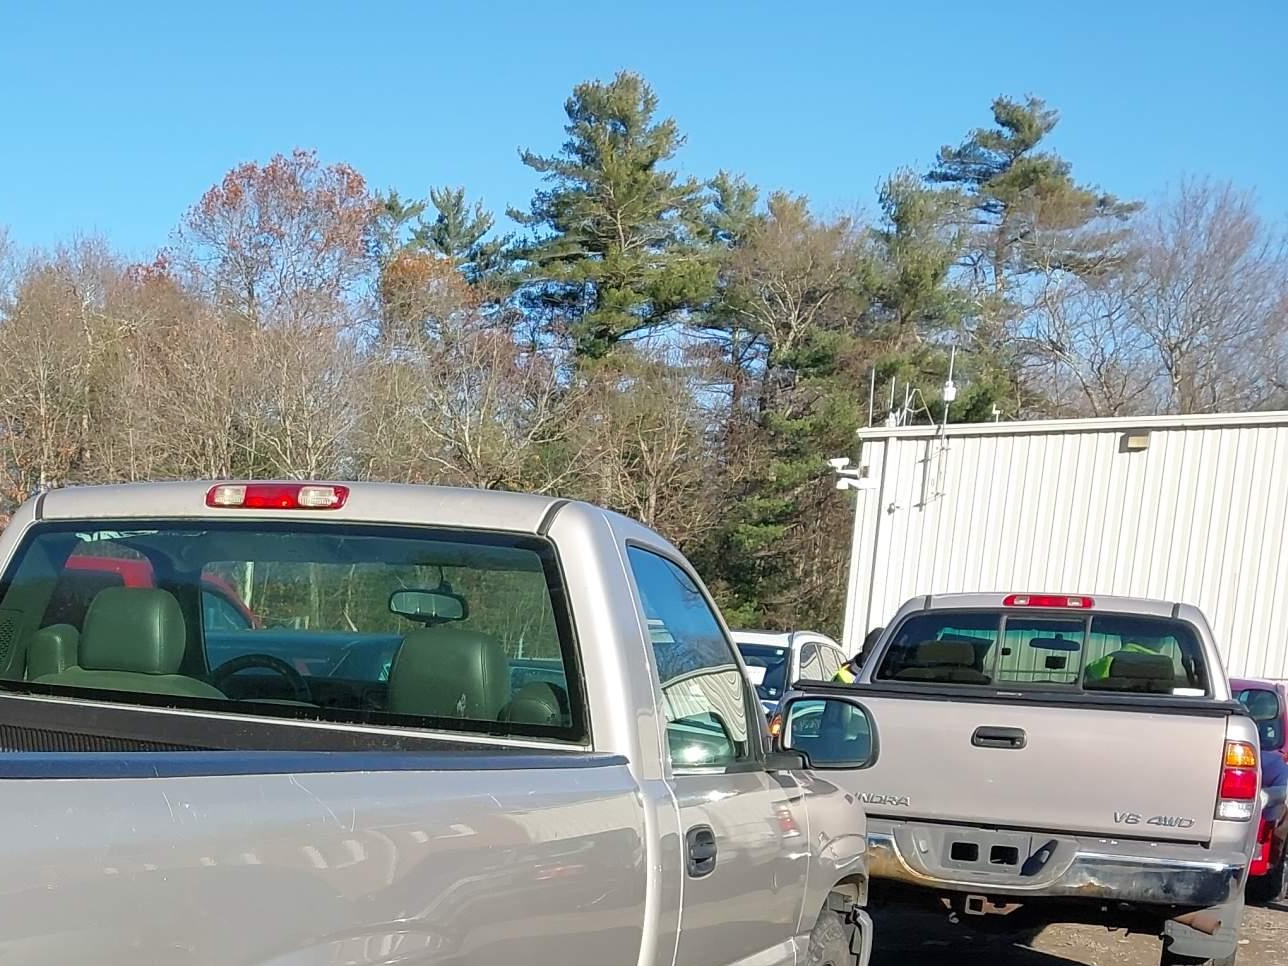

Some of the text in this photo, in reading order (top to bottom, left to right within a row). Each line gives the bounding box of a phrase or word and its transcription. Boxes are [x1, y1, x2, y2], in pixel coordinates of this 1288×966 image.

[854, 792, 911, 807] NDRA
[1113, 810, 1195, 828] V6 4WD
